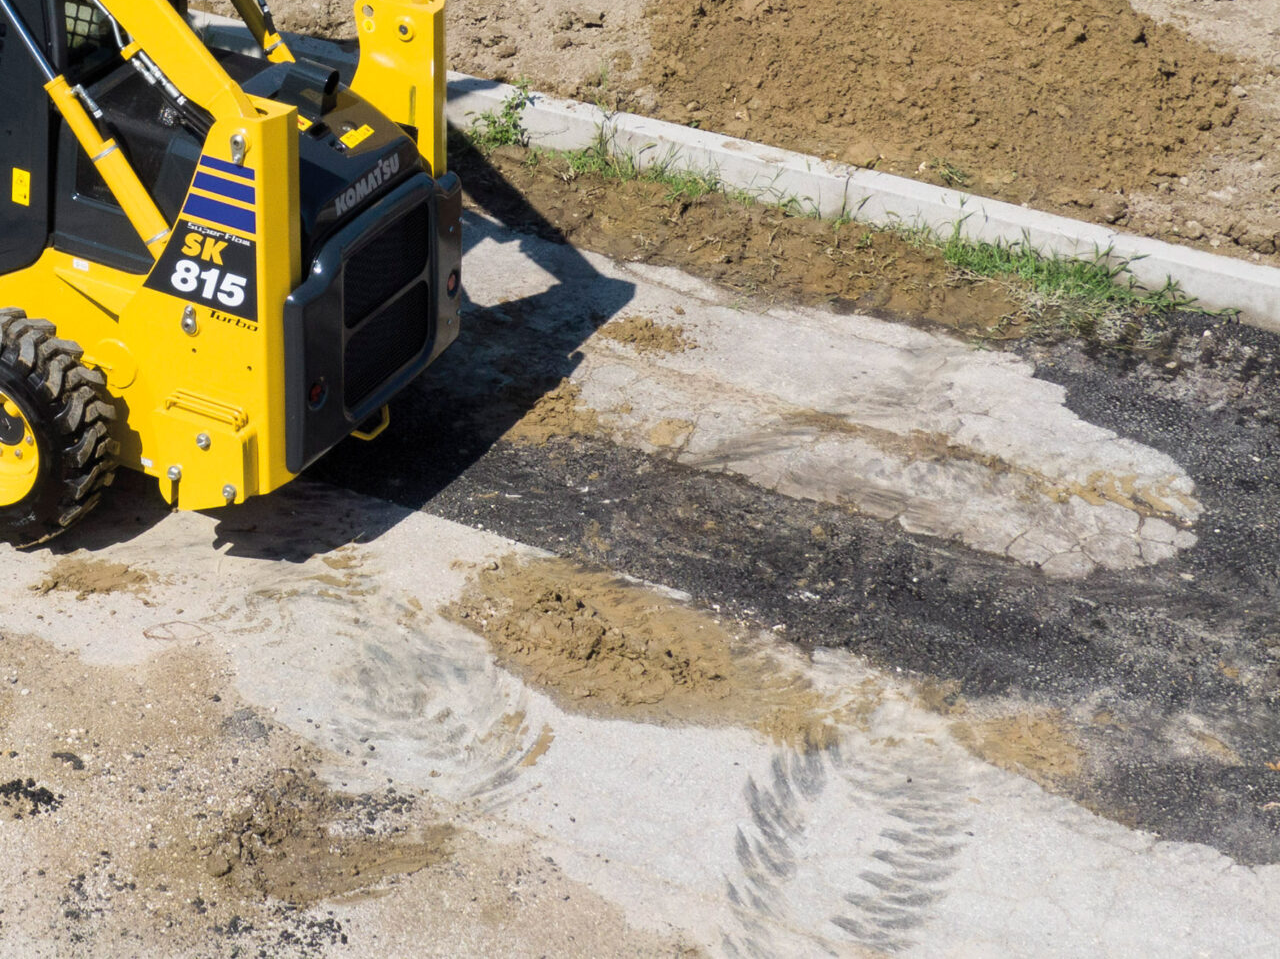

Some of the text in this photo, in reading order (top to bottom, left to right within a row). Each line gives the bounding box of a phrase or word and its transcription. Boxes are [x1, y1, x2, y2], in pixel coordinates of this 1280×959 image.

[334, 152, 400, 217] KOMATSU
[180, 232, 229, 266] SK
[170, 259, 248, 308] 815
[208, 308, 259, 332] Turbo
